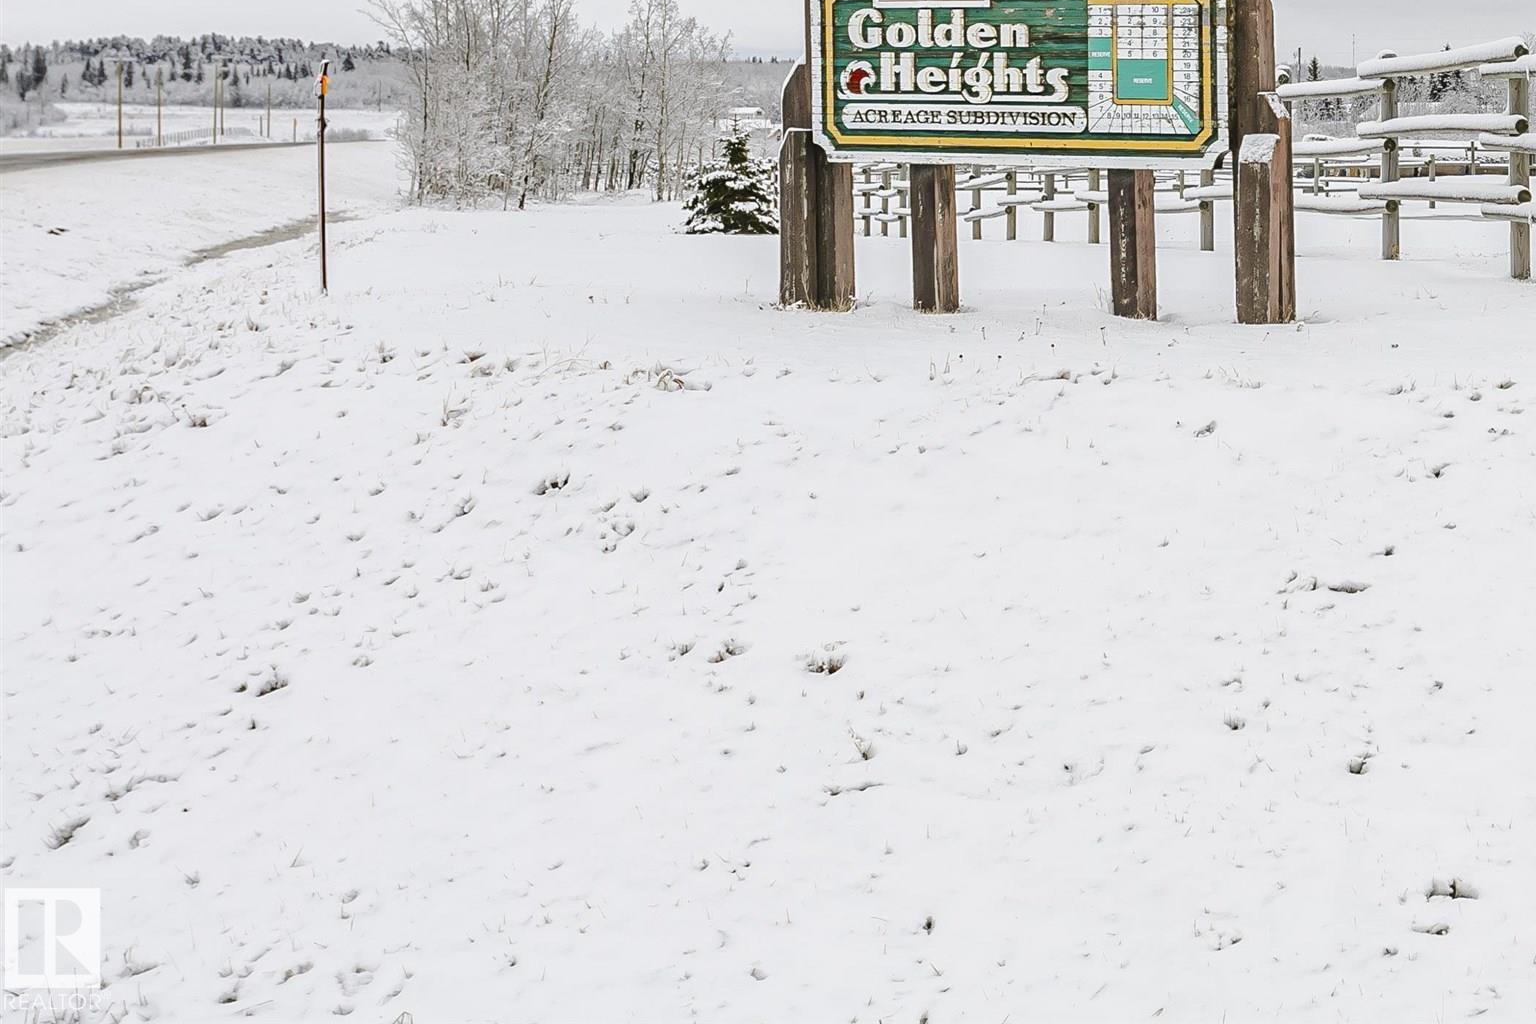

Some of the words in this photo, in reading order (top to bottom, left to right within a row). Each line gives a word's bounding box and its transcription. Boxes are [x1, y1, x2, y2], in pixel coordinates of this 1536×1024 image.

[848, 8, 1029, 49] Golden
[879, 51, 1069, 104] Heights
[852, 108, 942, 125] ACREAGE
[946, 109, 1077, 127] SUBDIVISION
